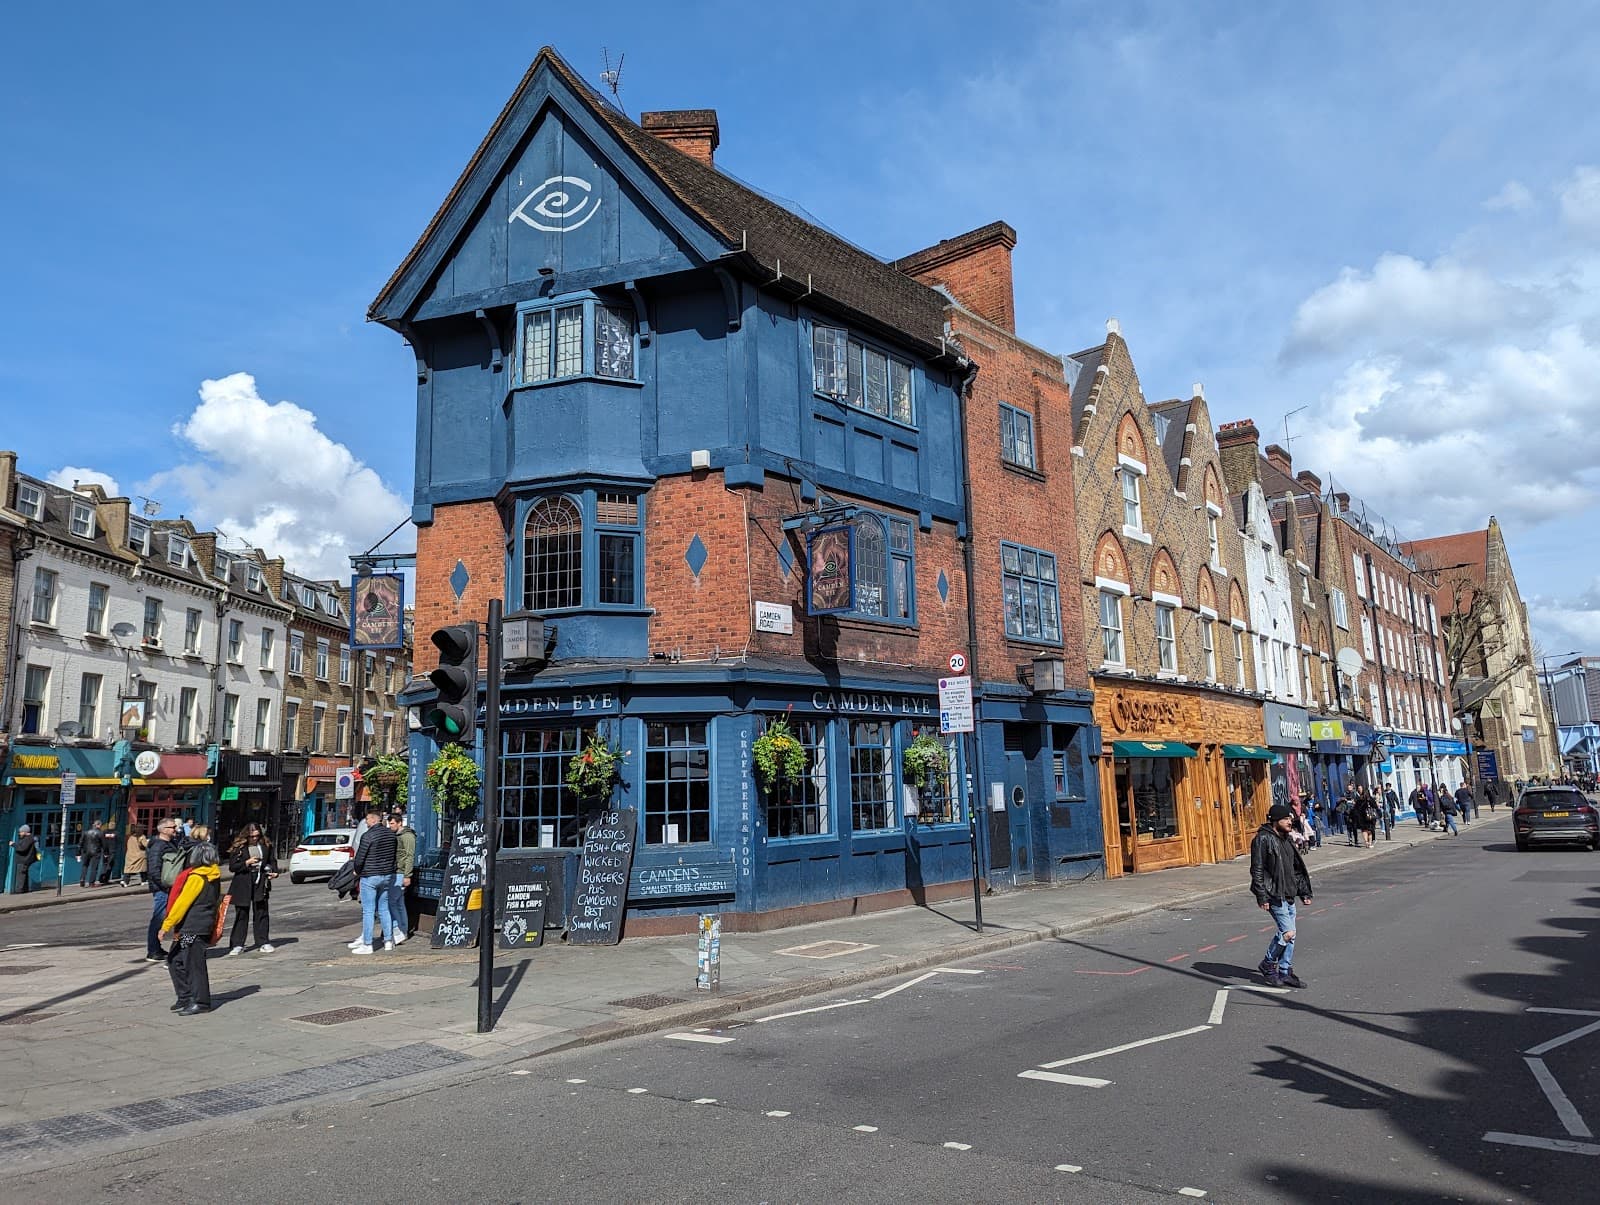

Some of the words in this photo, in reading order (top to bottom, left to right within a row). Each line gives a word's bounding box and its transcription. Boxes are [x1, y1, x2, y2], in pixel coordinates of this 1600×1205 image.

[759, 610, 781, 621] CAMDEN
[759, 619, 774, 629] ROAD
[951, 658, 964, 667] 20
[480, 696, 560, 714] AMDEN
[571, 692, 612, 711] EYE
[812, 691, 893, 712] CAMDEN
[901, 696, 930, 714] EYE
[741, 782, 749, 820] BEER
[600, 811, 618, 825] PUB
[587, 826, 625, 840] CLASSICS
[584, 855, 621, 867] WICKED
[742, 836, 750, 876] FOOD
[582, 869, 624, 885] BURGERS
[508, 883, 543, 893] TRADITIONAL
[589, 884, 605, 894] PLUS
[640, 884, 672, 895] SMALLEST
[675, 883, 693, 893] BEER
[507, 892, 530, 900] CAMDEN
[577, 894, 617, 906] CAMDENS
[506, 901, 519, 909] FISH
[520, 900, 525, 908] &
[526, 899, 543, 908] CHIPS
[584, 906, 604, 917] BEST
